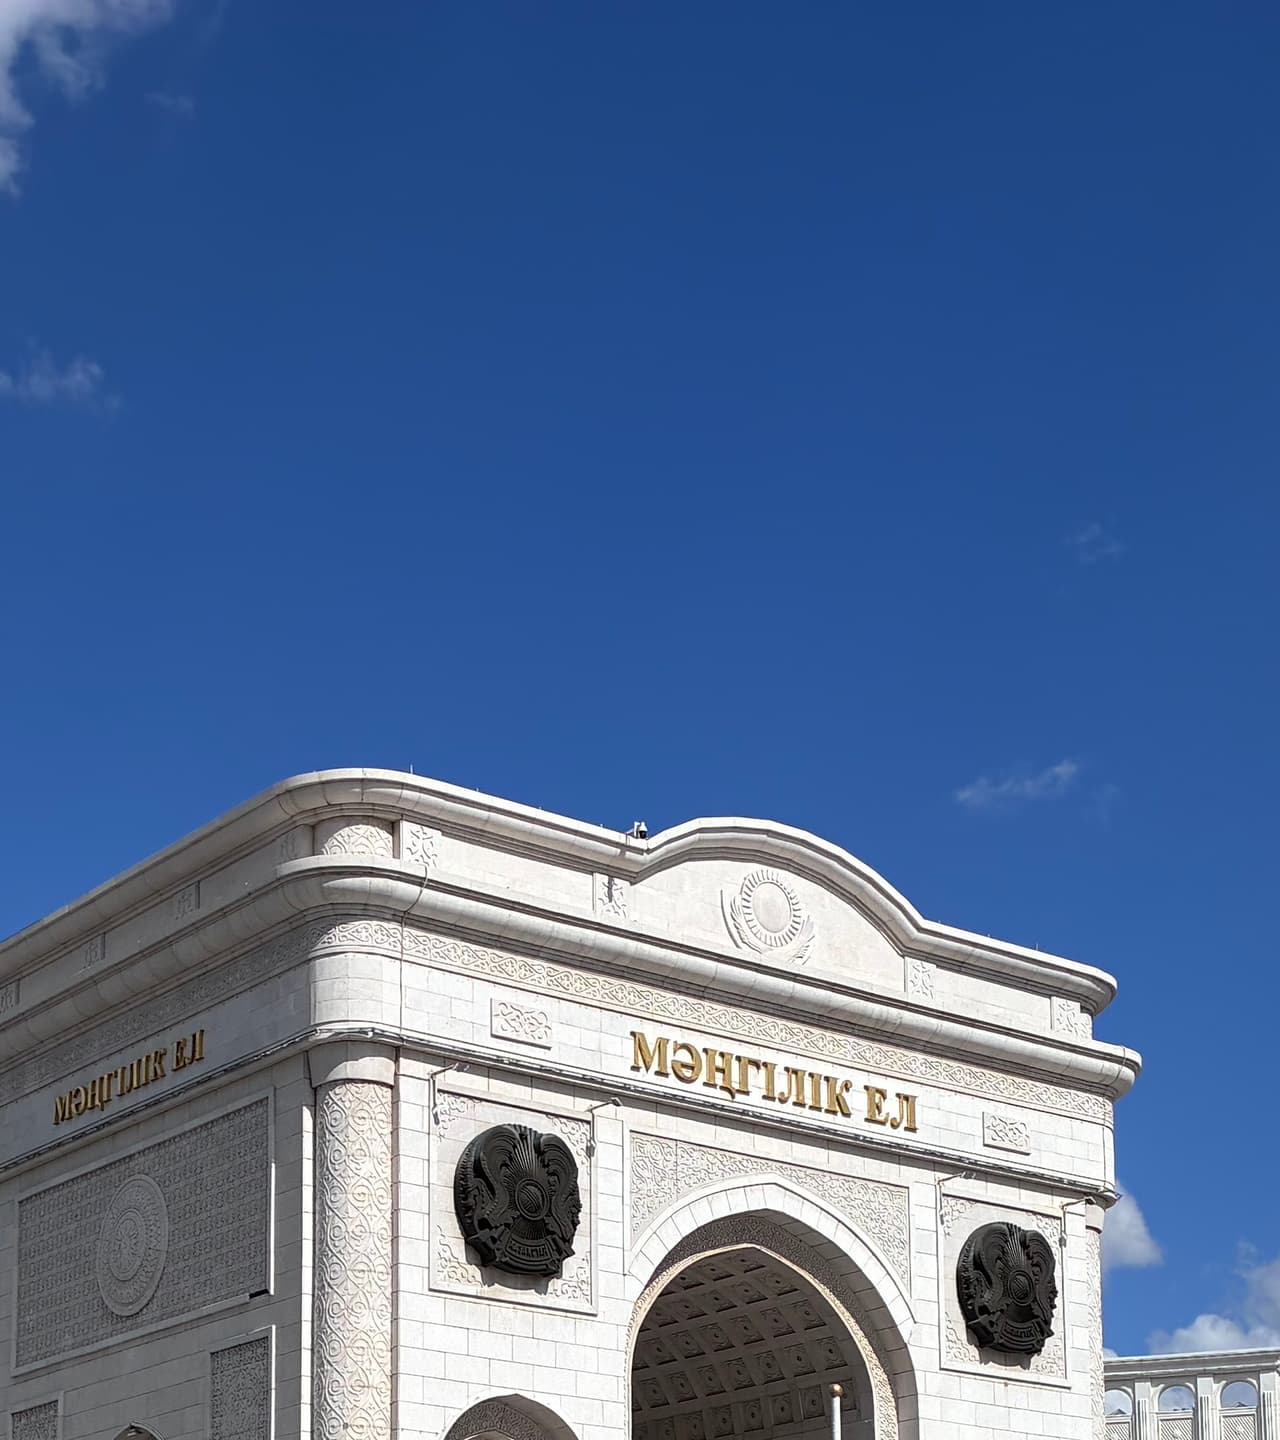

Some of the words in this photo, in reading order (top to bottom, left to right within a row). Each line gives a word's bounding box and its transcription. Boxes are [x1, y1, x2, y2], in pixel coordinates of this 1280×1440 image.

[53, 1048, 167, 1125] МӘҢГІЛІК
[172, 1029, 205, 1071] ЕЛ
[630, 1031, 853, 1118] МӘҢГІЛІК
[863, 1084, 919, 1133] ЕЛ
